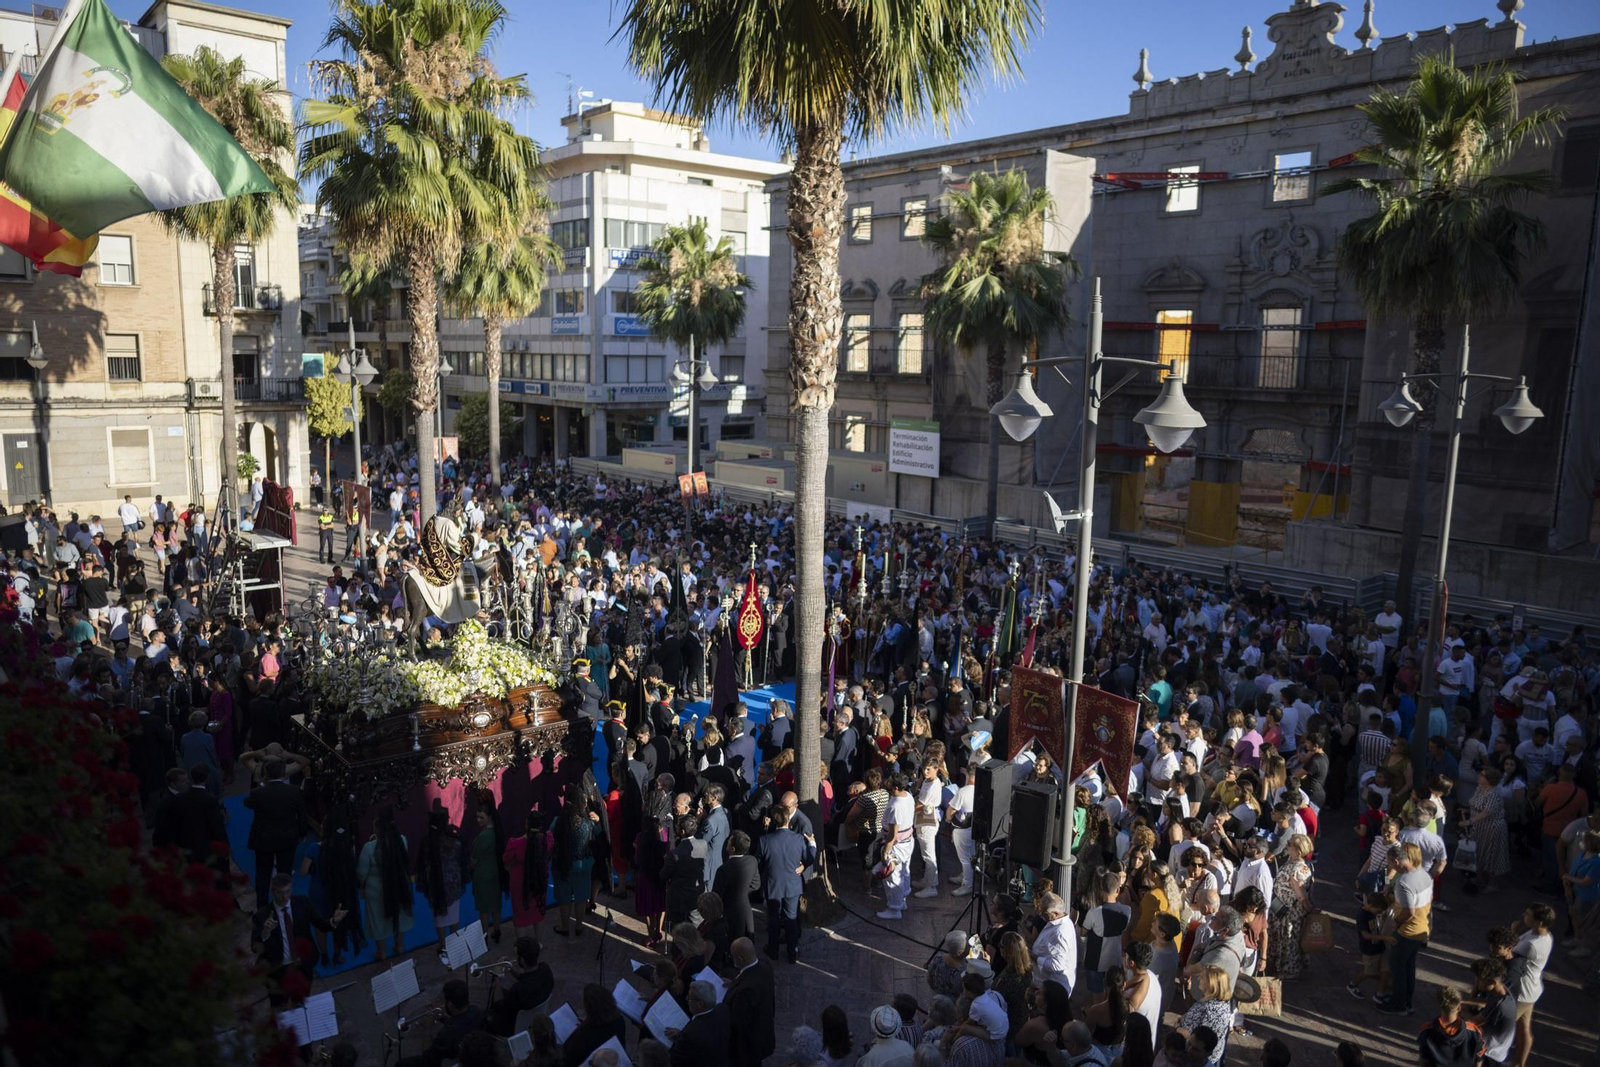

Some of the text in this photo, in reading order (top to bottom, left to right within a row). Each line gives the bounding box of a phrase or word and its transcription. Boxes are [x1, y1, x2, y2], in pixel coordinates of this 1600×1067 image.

[620, 386, 667, 394] PREVENTIVA
[893, 432, 928, 441] Terminación
[892, 440, 934, 451] Rehabilitación
[892, 449, 913, 458] Edificio
[892, 458, 935, 469] Administrativo
